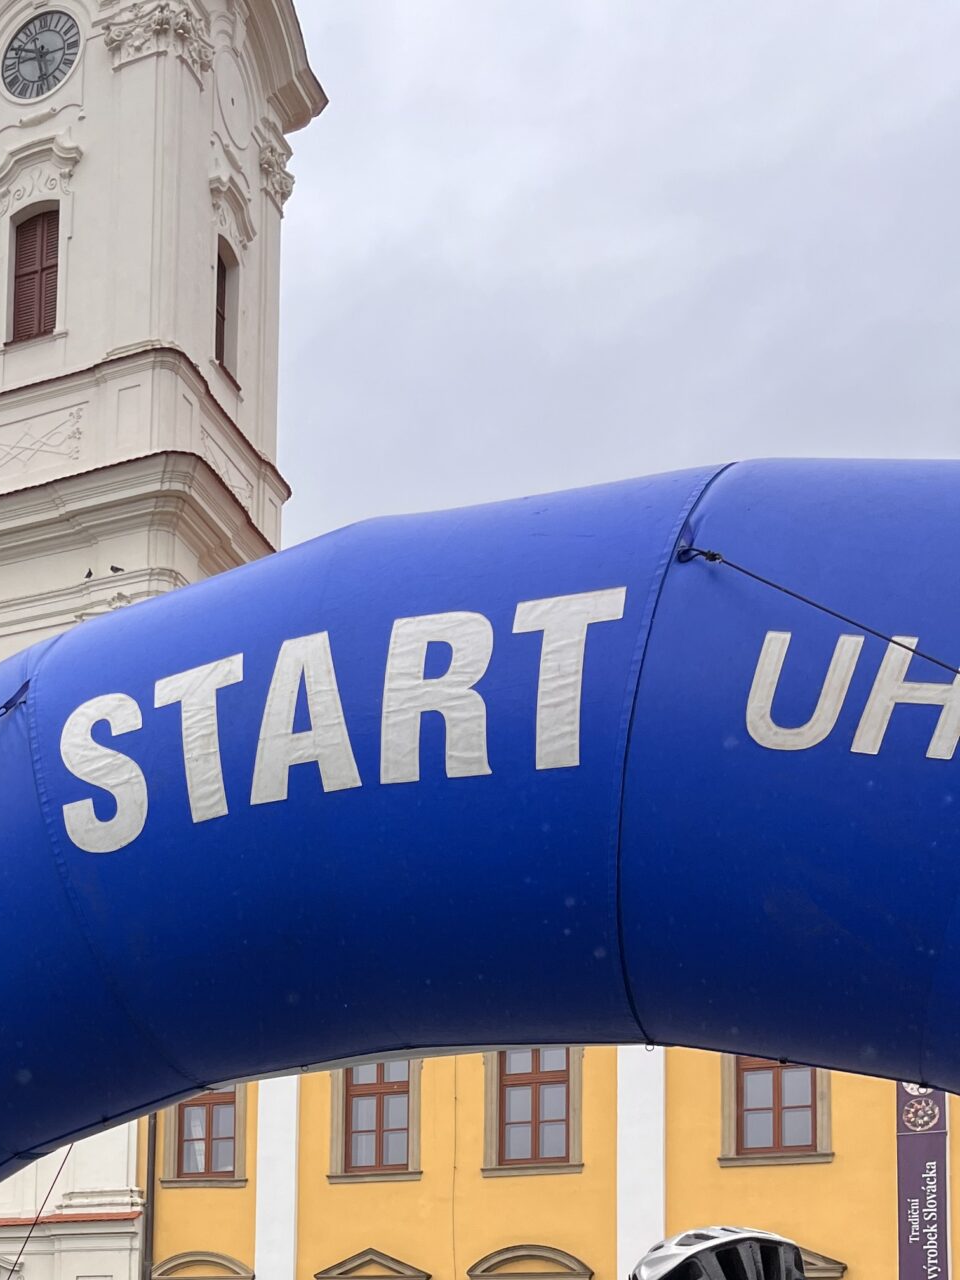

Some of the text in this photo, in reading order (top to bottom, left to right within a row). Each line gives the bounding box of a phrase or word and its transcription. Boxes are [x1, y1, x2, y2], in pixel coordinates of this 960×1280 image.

[58, 585, 628, 855] START
[744, 629, 960, 760] UH
[907, 1198, 920, 1244] Tradiční
[921, 1161, 941, 1280] výrobek Slovácka
